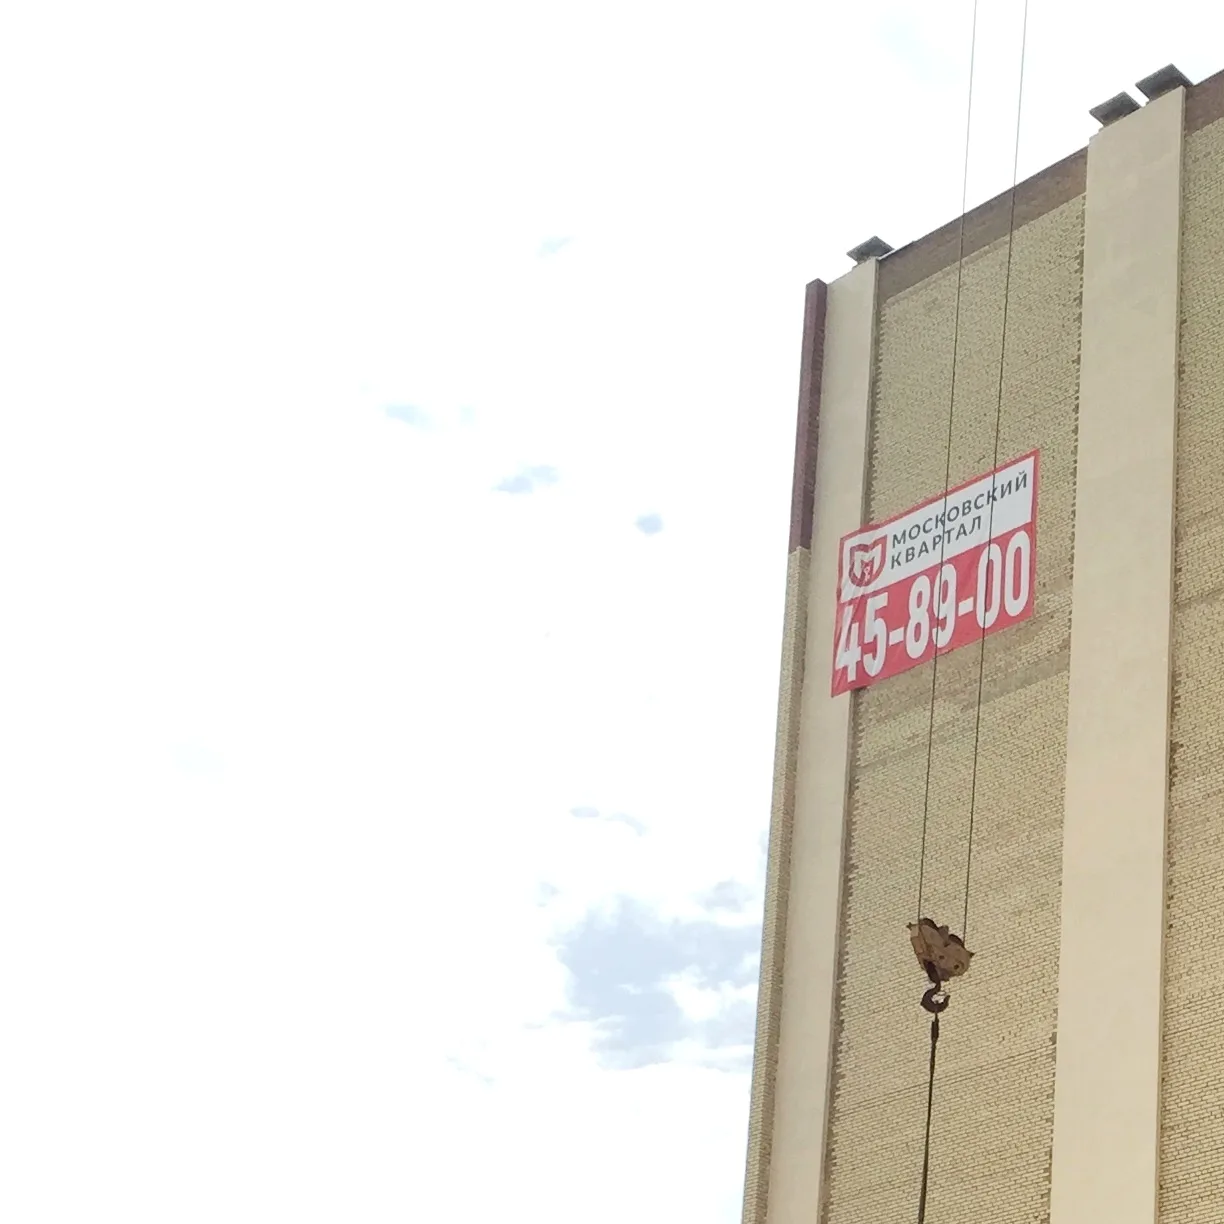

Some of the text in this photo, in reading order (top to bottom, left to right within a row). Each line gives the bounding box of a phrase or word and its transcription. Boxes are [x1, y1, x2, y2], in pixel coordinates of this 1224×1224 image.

[890, 515, 982, 569] КВАРТАЛ
[892, 470, 1028, 549] МОСКОВСКИЙ
[835, 530, 1031, 683] 45-89-00
